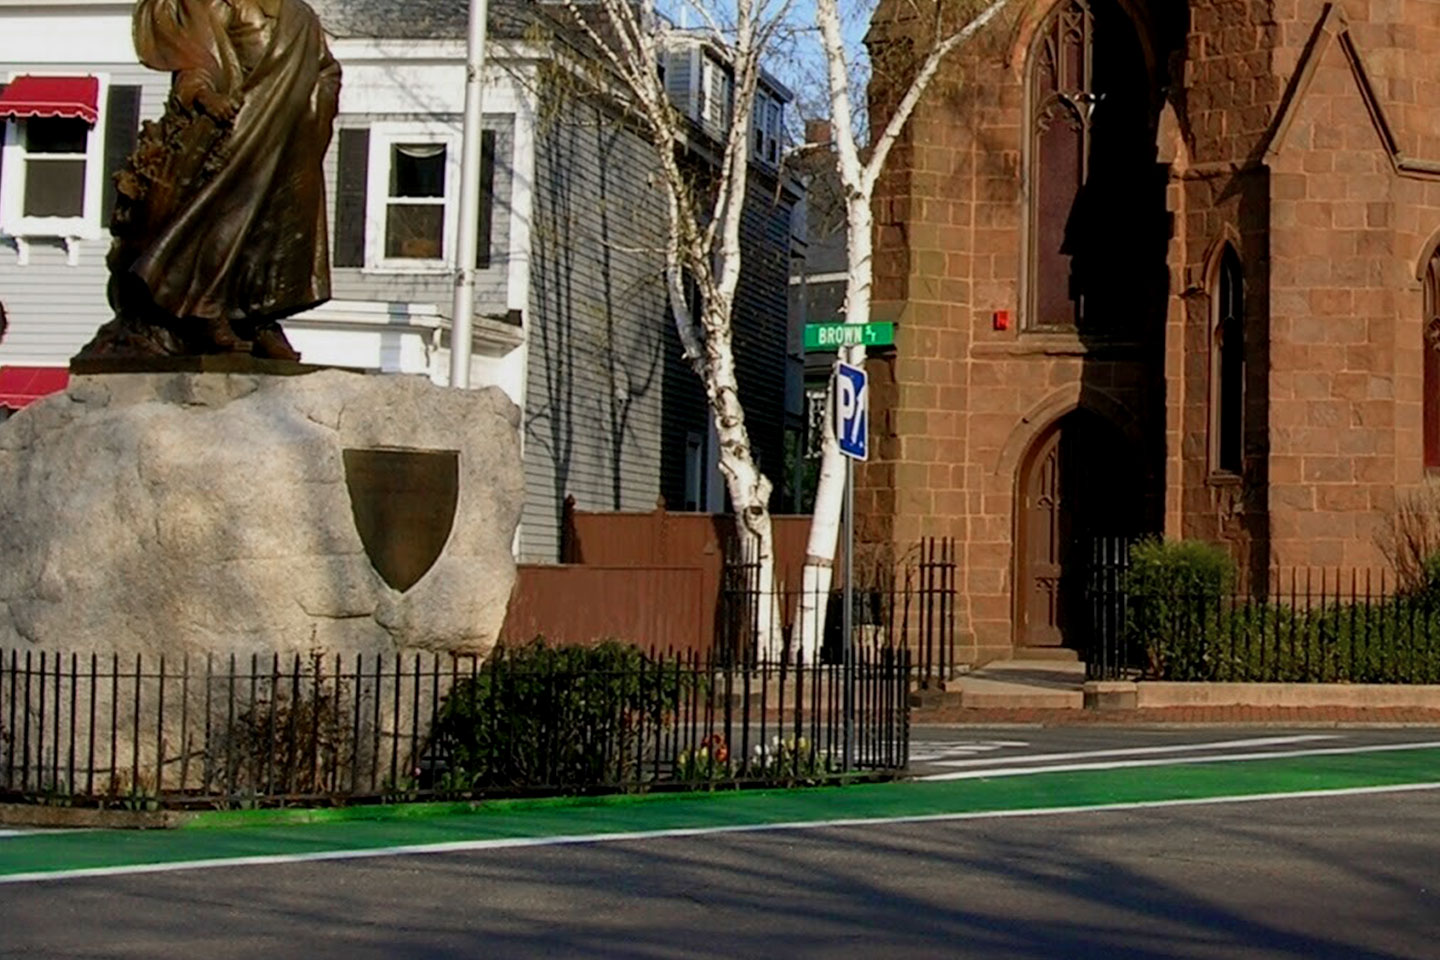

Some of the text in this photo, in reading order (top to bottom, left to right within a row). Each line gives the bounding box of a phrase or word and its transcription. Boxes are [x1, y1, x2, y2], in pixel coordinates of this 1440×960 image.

[819, 325, 876, 344] BROWN ST
[838, 374, 855, 440] P
